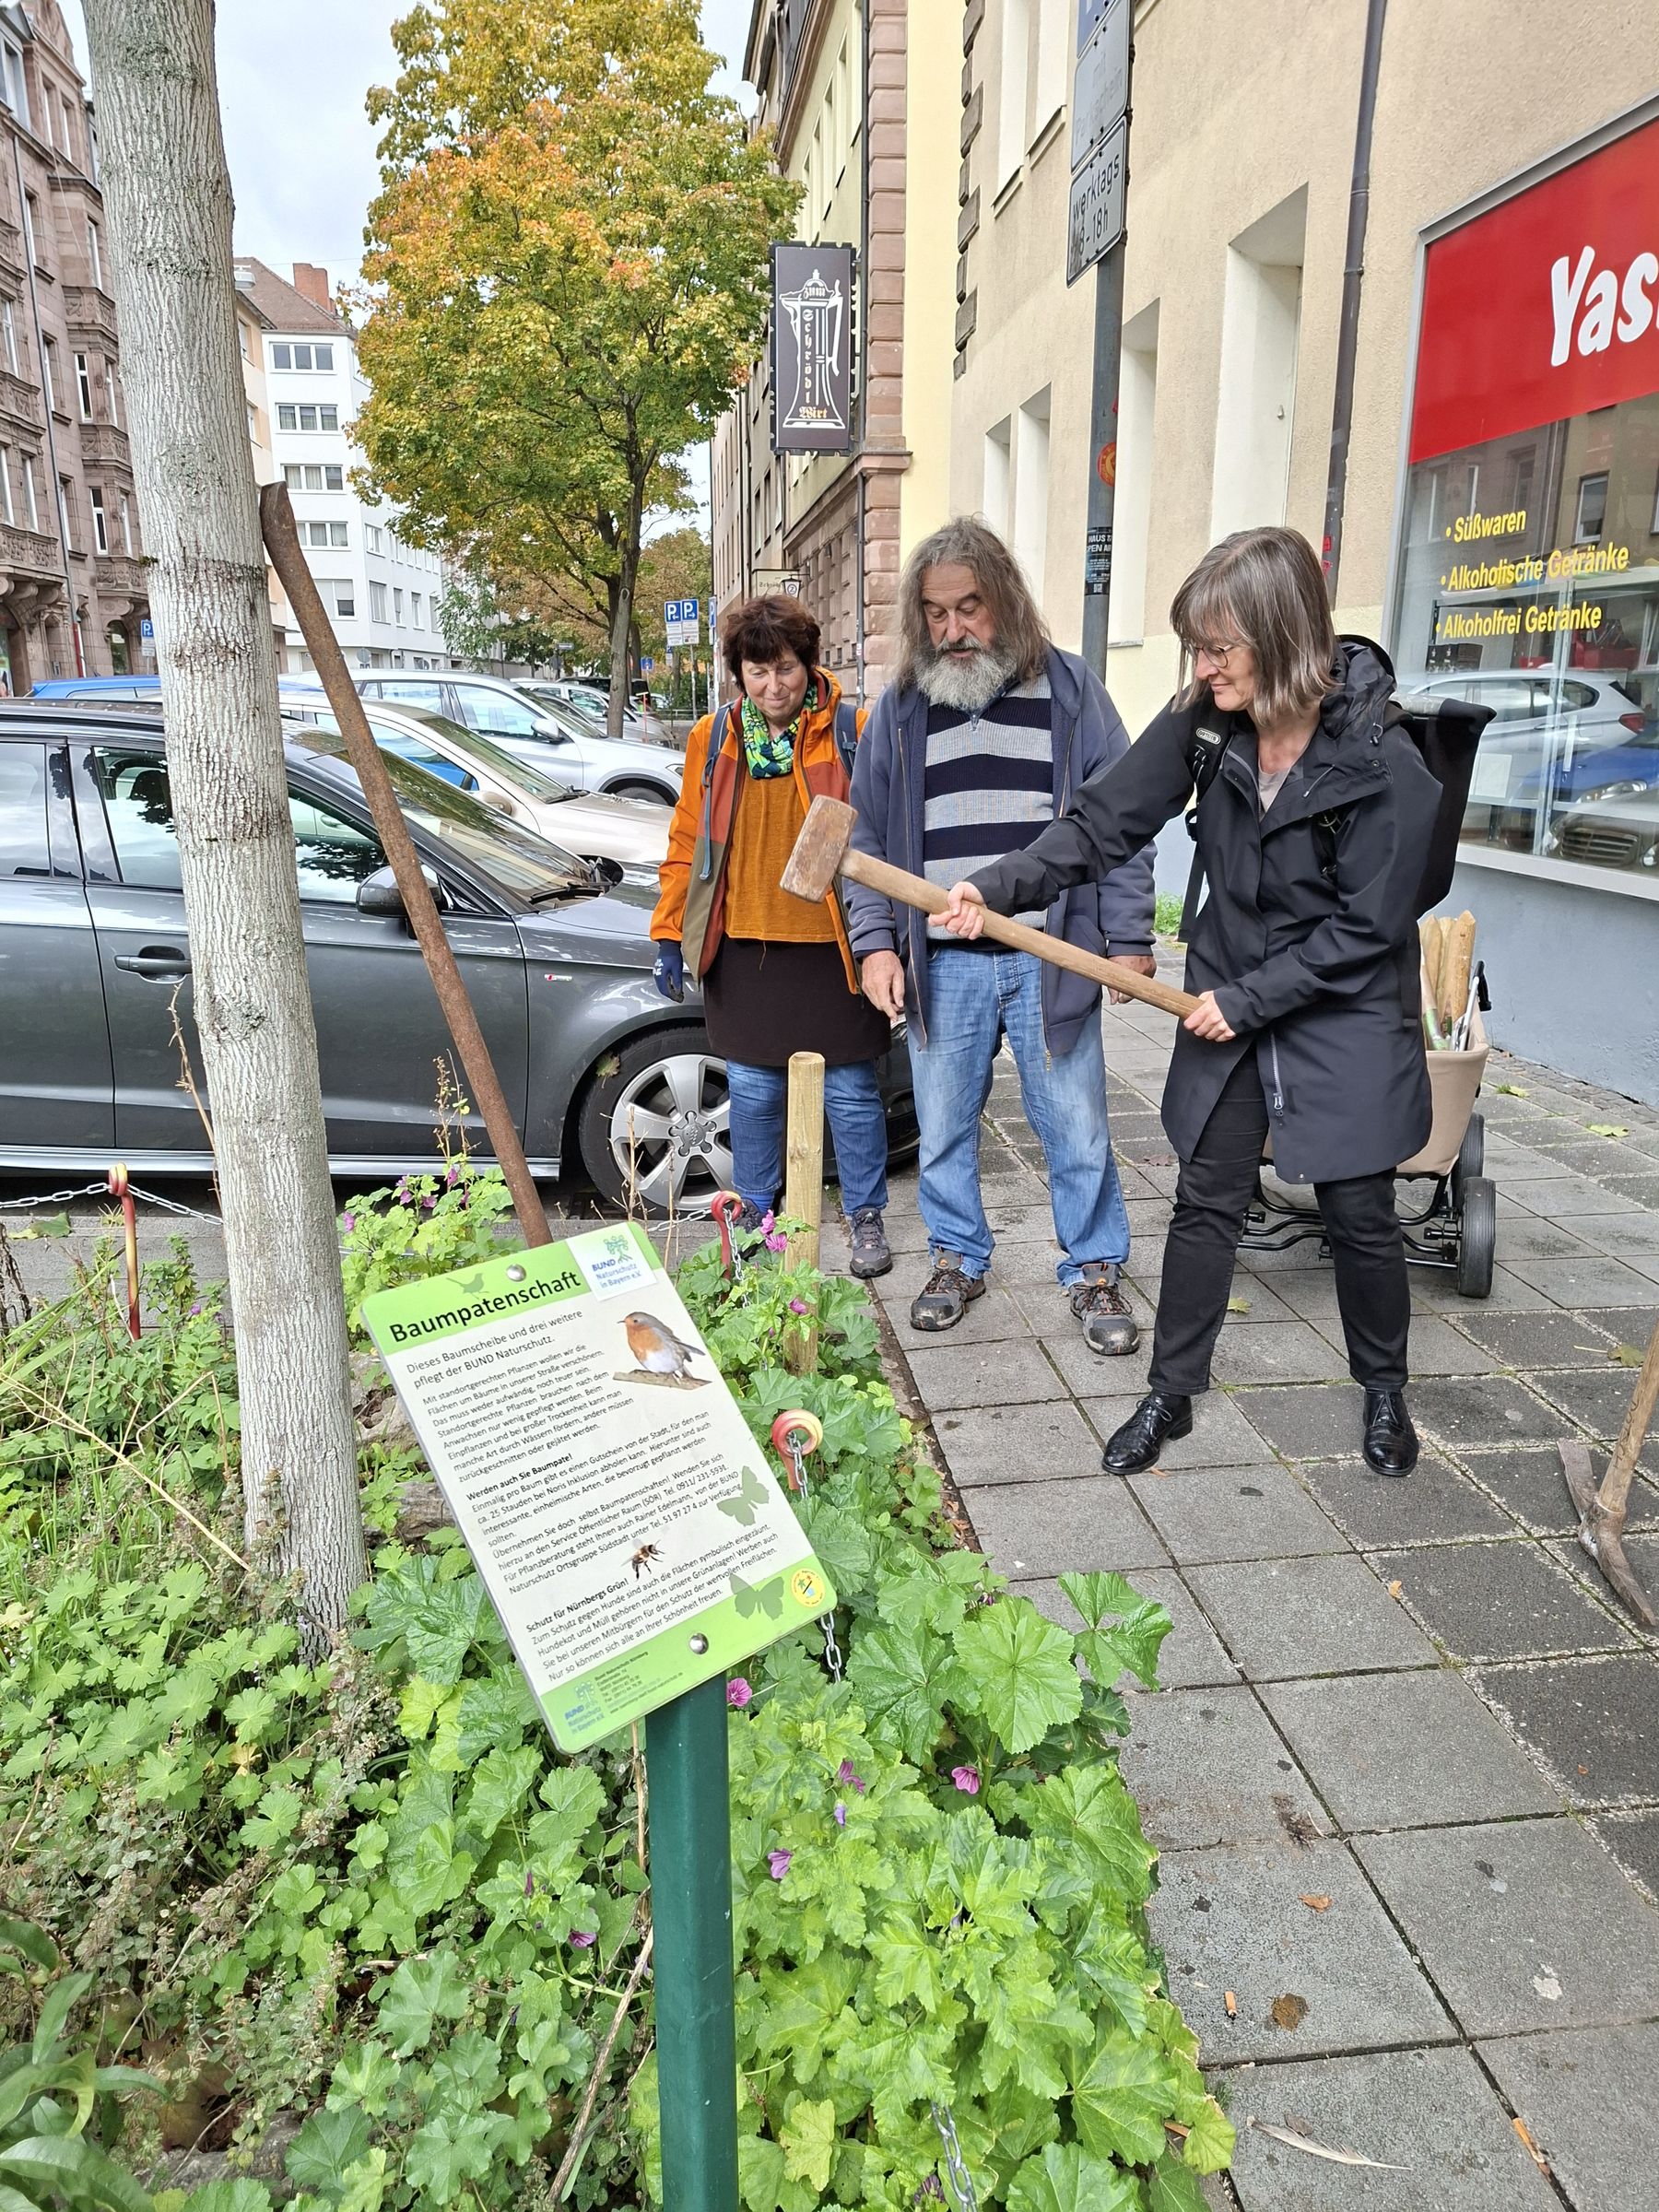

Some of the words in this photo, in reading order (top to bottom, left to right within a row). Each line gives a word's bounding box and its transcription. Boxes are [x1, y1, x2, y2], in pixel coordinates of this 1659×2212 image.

[1073, 154, 1119, 220] werktags
[1551, 245, 1659, 367] Yas
[799, 406, 828, 418] Wirt
[1454, 510, 1526, 543] Süßwaren
[1448, 556, 1543, 591] Alkoholische
[1547, 542, 1629, 578] Getränke
[668, 605, 677, 620] P
[684, 603, 693, 618] P
[1443, 607, 1522, 639] Alkoholfrei
[1525, 601, 1602, 633] Getränke
[592, 1259, 616, 1271] BUND
[596, 1264, 637, 1278] Naturschutz
[608, 1275, 631, 1287] Bayern
[389, 1271, 581, 1342] Baumpatenschaft
[406, 1357, 441, 1373] Dieses
[441, 1335, 507, 1361] Baumscheibe
[508, 1326, 527, 1339] und
[528, 1320, 547, 1335] drei
[547, 1311, 582, 1326] weitere
[413, 1371, 444, 1390] pflegt
[445, 1365, 462, 1377] der
[463, 1353, 494, 1371] BUND
[494, 1335, 555, 1359] Naturschutz.
[437, 1409, 503, 1438] Standortgerechte
[505, 1397, 537, 1413] Pflanzen
[538, 1384, 573, 1400] brauchen
[575, 1376, 593, 1387] nach
[593, 1371, 609, 1381] dem
[443, 1429, 487, 1449] Anwachsen
[488, 1422, 500, 1432] nur
[501, 1414, 525, 1427] wenig
[524, 1402, 555, 1419] gepflegt
[555, 1393, 583, 1406] werden.
[583, 1385, 603, 1395] Beim
[447, 1439, 493, 1460] Einpflanzen
[493, 1430, 509, 1442] und
[508, 1426, 522, 1437] bei
[522, 1416, 547, 1433] großer
[547, 1402, 588, 1422] Trockenheit
[587, 1395, 606, 1406] kann
[606, 1390, 621, 1399] man
[453, 1454, 485, 1471] manche
[486, 1449, 498, 1459] Art
[499, 1440, 521, 1453] durch
[520, 1429, 553, 1444] Wässern
[552, 1418, 582, 1432] fördern,
[582, 1407, 607, 1421] andere
[607, 1397, 633, 1411] müssen
[458, 1452, 526, 1482] zurückgeschnitten
[526, 1443, 544, 1455] oder
[545, 1433, 571, 1450] gejätet
[571, 1423, 599, 1437] werden.
[465, 1484, 499, 1500] Werden
[499, 1475, 519, 1488] auch
[518, 1471, 531, 1480] Sie
[531, 1452, 572, 1475] Baumpate!
[481, 1512, 532, 1535] interessante,
[532, 1489, 581, 1514] einheimische
[581, 1481, 604, 1493] Arten,
[604, 1475, 616, 1483] die
[615, 1460, 650, 1478] bevorzugt
[650, 1446, 681, 1465] gepflanzt
[681, 1437, 706, 1450] werden
[492, 1533, 544, 1559] Übernehmen
[543, 1526, 557, 1536] Sie
[557, 1517, 576, 1531] doch
[578, 1507, 600, 1522] selbst
[599, 1475, 670, 1512] Baumpatenschaften!
[671, 1464, 700, 1481] Wenden
[699, 1459, 711, 1467] Sie
[710, 1453, 724, 1463] sich
[488, 1532, 517, 1547] sollten.
[497, 1556, 524, 1571] hierzu
[524, 1549, 535, 1559] an
[535, 1542, 550, 1554] den
[549, 1531, 578, 1547] Service
[577, 1508, 620, 1535] Öffentlicher
[620, 1502, 642, 1515] Raum
[502, 1571, 516, 1583] Für
[517, 1546, 576, 1576] Pflanzberatung
[575, 1536, 595, 1550] steht
[594, 1527, 617, 1541] Ihnen
[616, 1518, 634, 1531] auch
[633, 1508, 656, 1523] Rainer
[656, 1493, 693, 1512] Edelmann,
[694, 1486, 708, 1495] von
[707, 1480, 719, 1489] der
[719, 1470, 738, 1484] BUND
[508, 1569, 556, 1594] Naturschutz
[555, 1549, 598, 1572] Ortsgruppe
[597, 1534, 630, 1553] Südstadt
[629, 1525, 649, 1541] unter
[662, 1513, 673, 1524] 51
[672, 1509, 681, 1519] 97
[681, 1504, 690, 1514] 27
[698, 1498, 708, 1507] zur
[525, 1615, 553, 1632] Schutz
[552, 1608, 565, 1619] für
[565, 1589, 606, 1613] Nürnbergs
[606, 1577, 629, 1593] Grün!
[531, 1631, 550, 1644] Zum
[549, 1618, 576, 1636] Schutz
[576, 1607, 600, 1624] gegen
[599, 1594, 626, 1611] Hunde
[626, 1584, 641, 1599] sind
[641, 1577, 660, 1590] auch
[660, 1571, 671, 1582] die
[671, 1559, 699, 1575] Flächen
[699, 1540, 735, 1563] symbolisch
[735, 1524, 771, 1544] eingezäunt.
[536, 1633, 576, 1657] Hundekot
[575, 1623, 592, 1637] und
[591, 1615, 610, 1630] Müll
[610, 1601, 641, 1622] gehören
[641, 1591, 660, 1605] nicht
[667, 1575, 693, 1591] unsere
[691, 1551, 736, 1579] Grünanlagen!
[735, 1540, 762, 1557] Werben
[762, 1532, 778, 1544] auch
[542, 1659, 556, 1669] Sie
[555, 1650, 570, 1663] bei
[570, 1636, 601, 1655] unseren
[600, 1615, 643, 1640] Mitbürgern
[642, 1608, 654, 1618] für
[655, 1601, 669, 1612] den
[669, 1589, 693, 1605] Schutz
[693, 1582, 705, 1593] der
[740, 1547, 777, 1569] Freiflächen.
